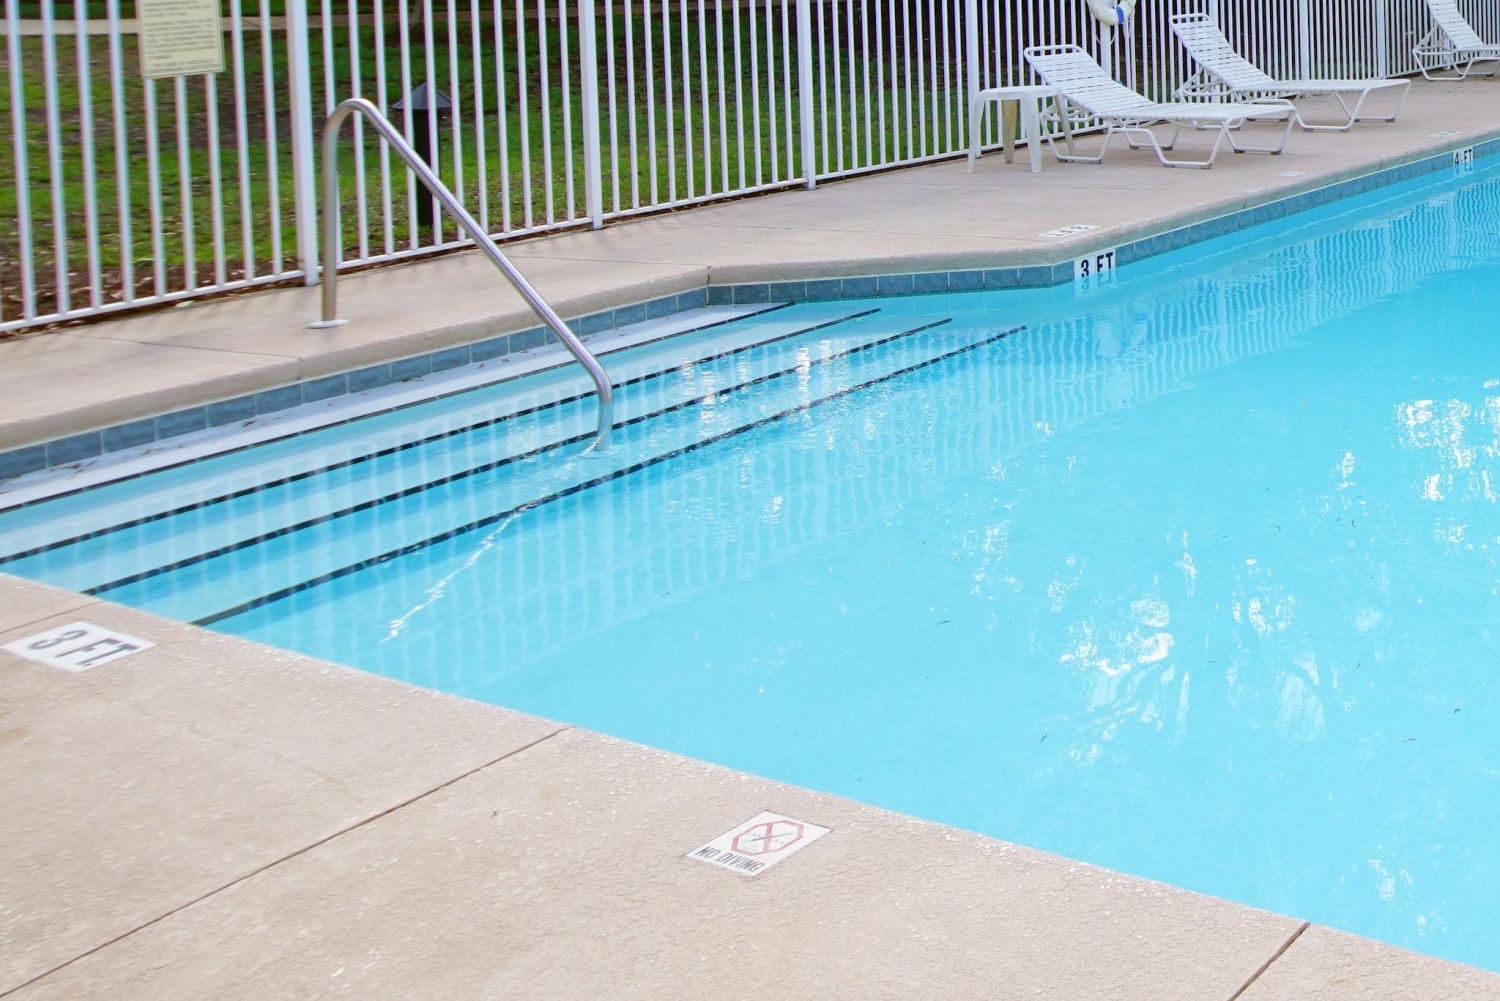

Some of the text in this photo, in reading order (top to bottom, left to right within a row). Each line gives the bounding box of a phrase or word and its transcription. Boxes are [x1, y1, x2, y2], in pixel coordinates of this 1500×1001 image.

[1081, 251, 1114, 277] 3 FT
[28, 629, 89, 650] 3
[695, 846, 765, 872] NO DIVING
